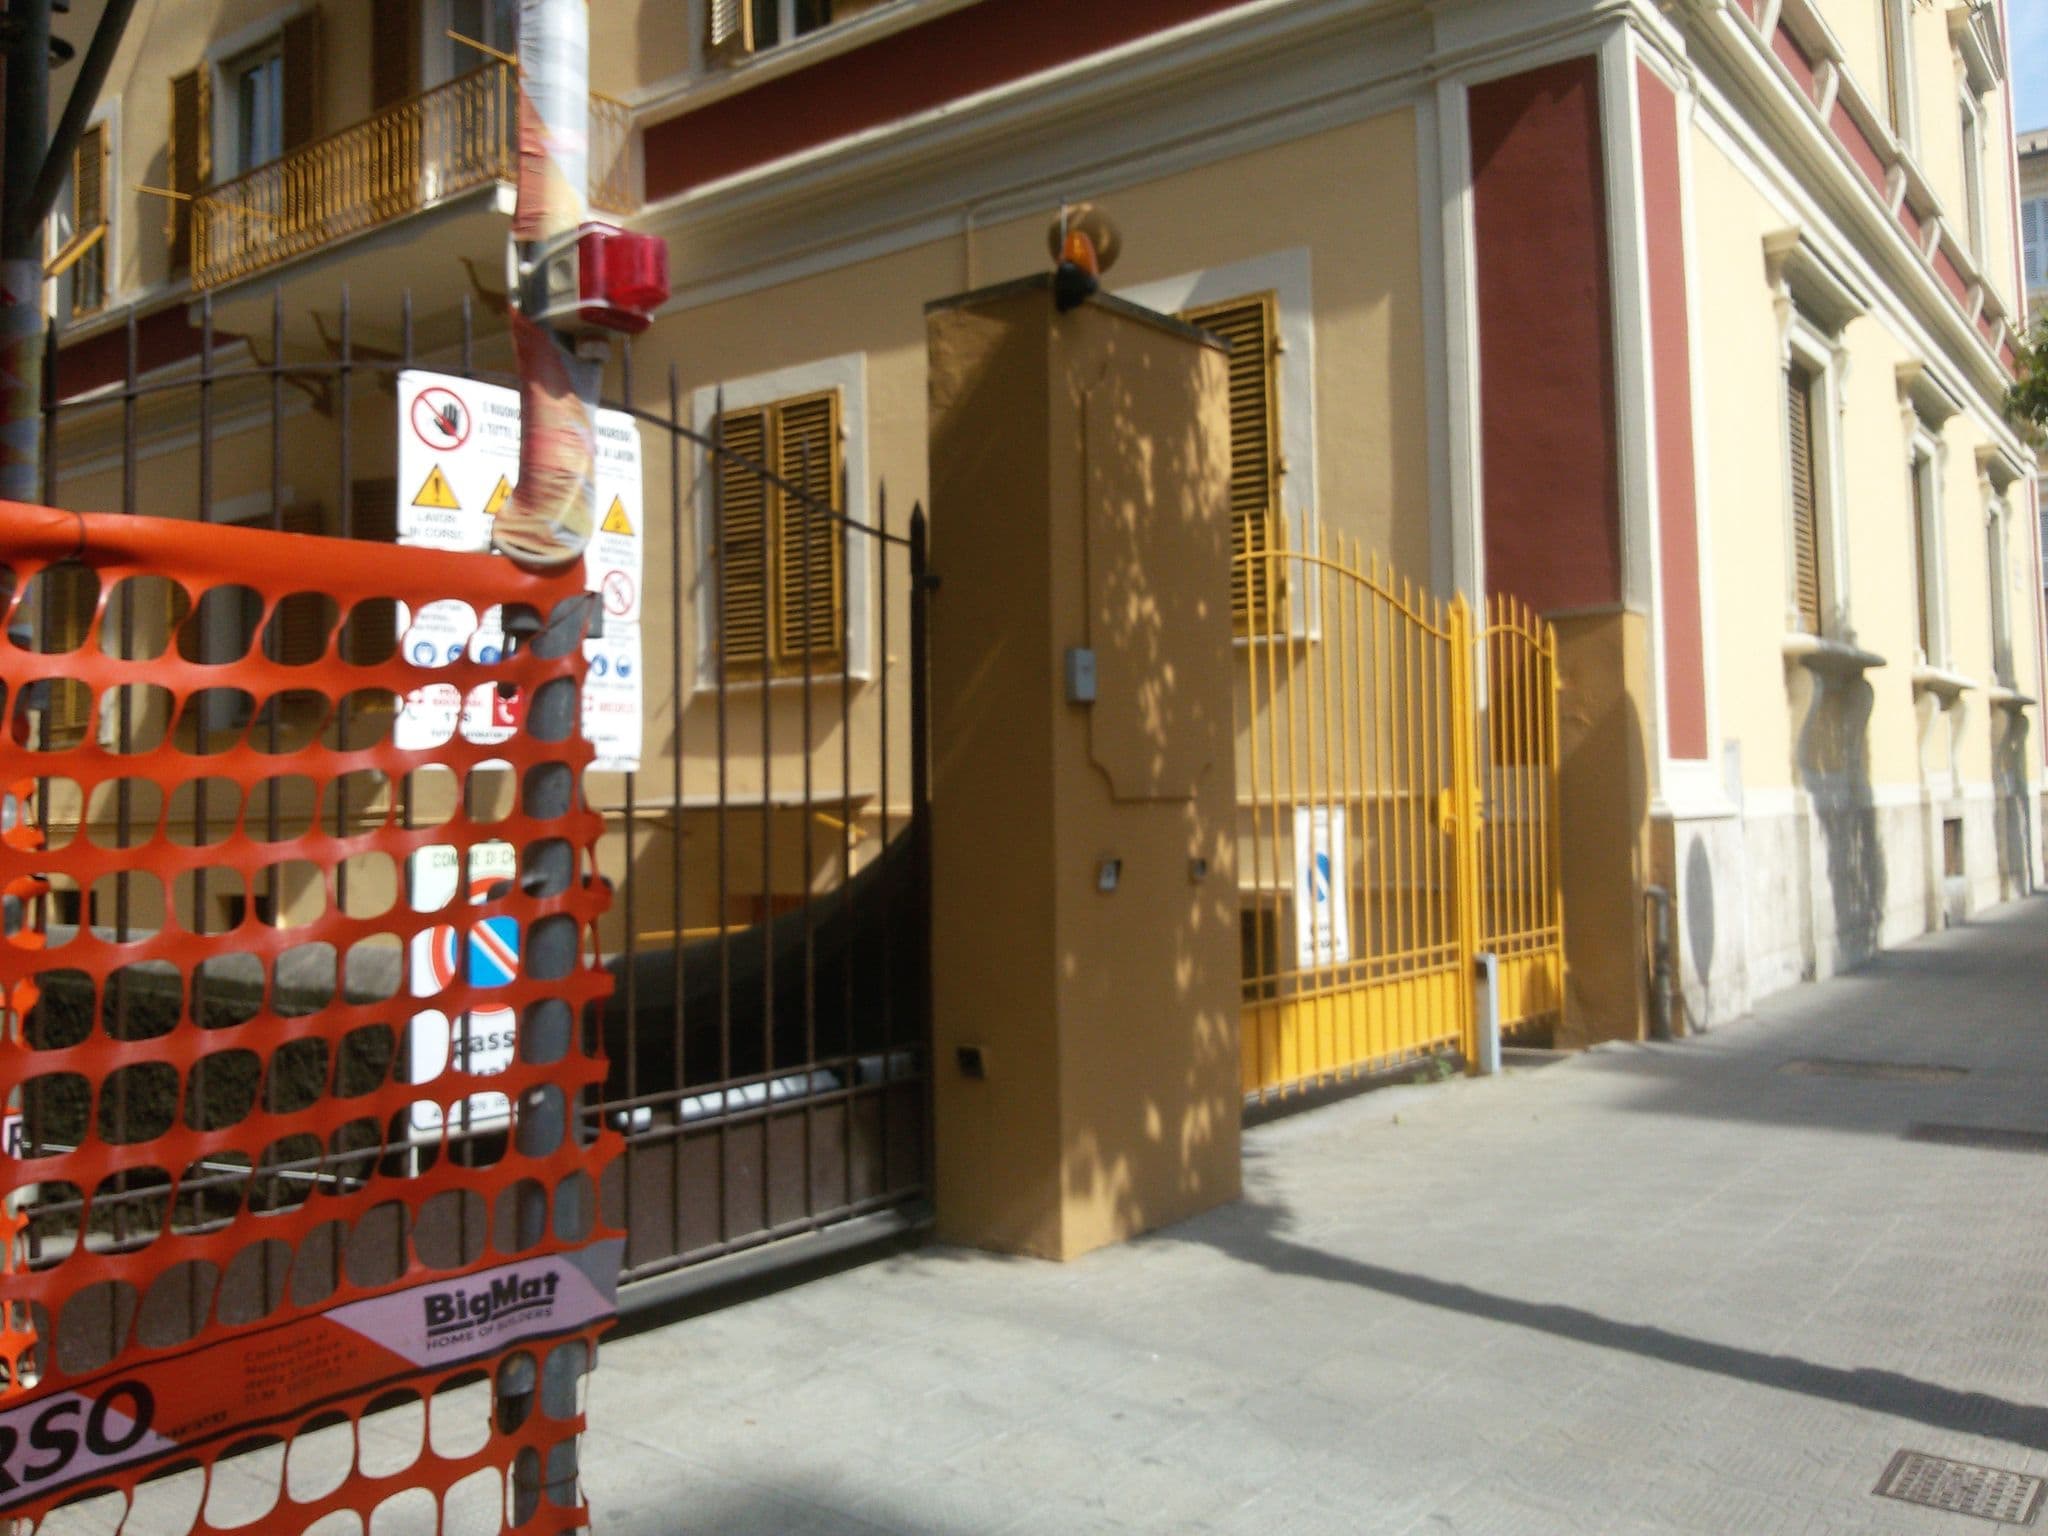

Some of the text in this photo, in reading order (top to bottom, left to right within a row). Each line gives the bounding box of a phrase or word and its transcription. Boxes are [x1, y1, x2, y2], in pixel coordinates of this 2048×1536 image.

[424, 1270, 560, 1326] BigMat
[426, 1331, 473, 1351] HOME
[478, 1324, 494, 1338] OF
